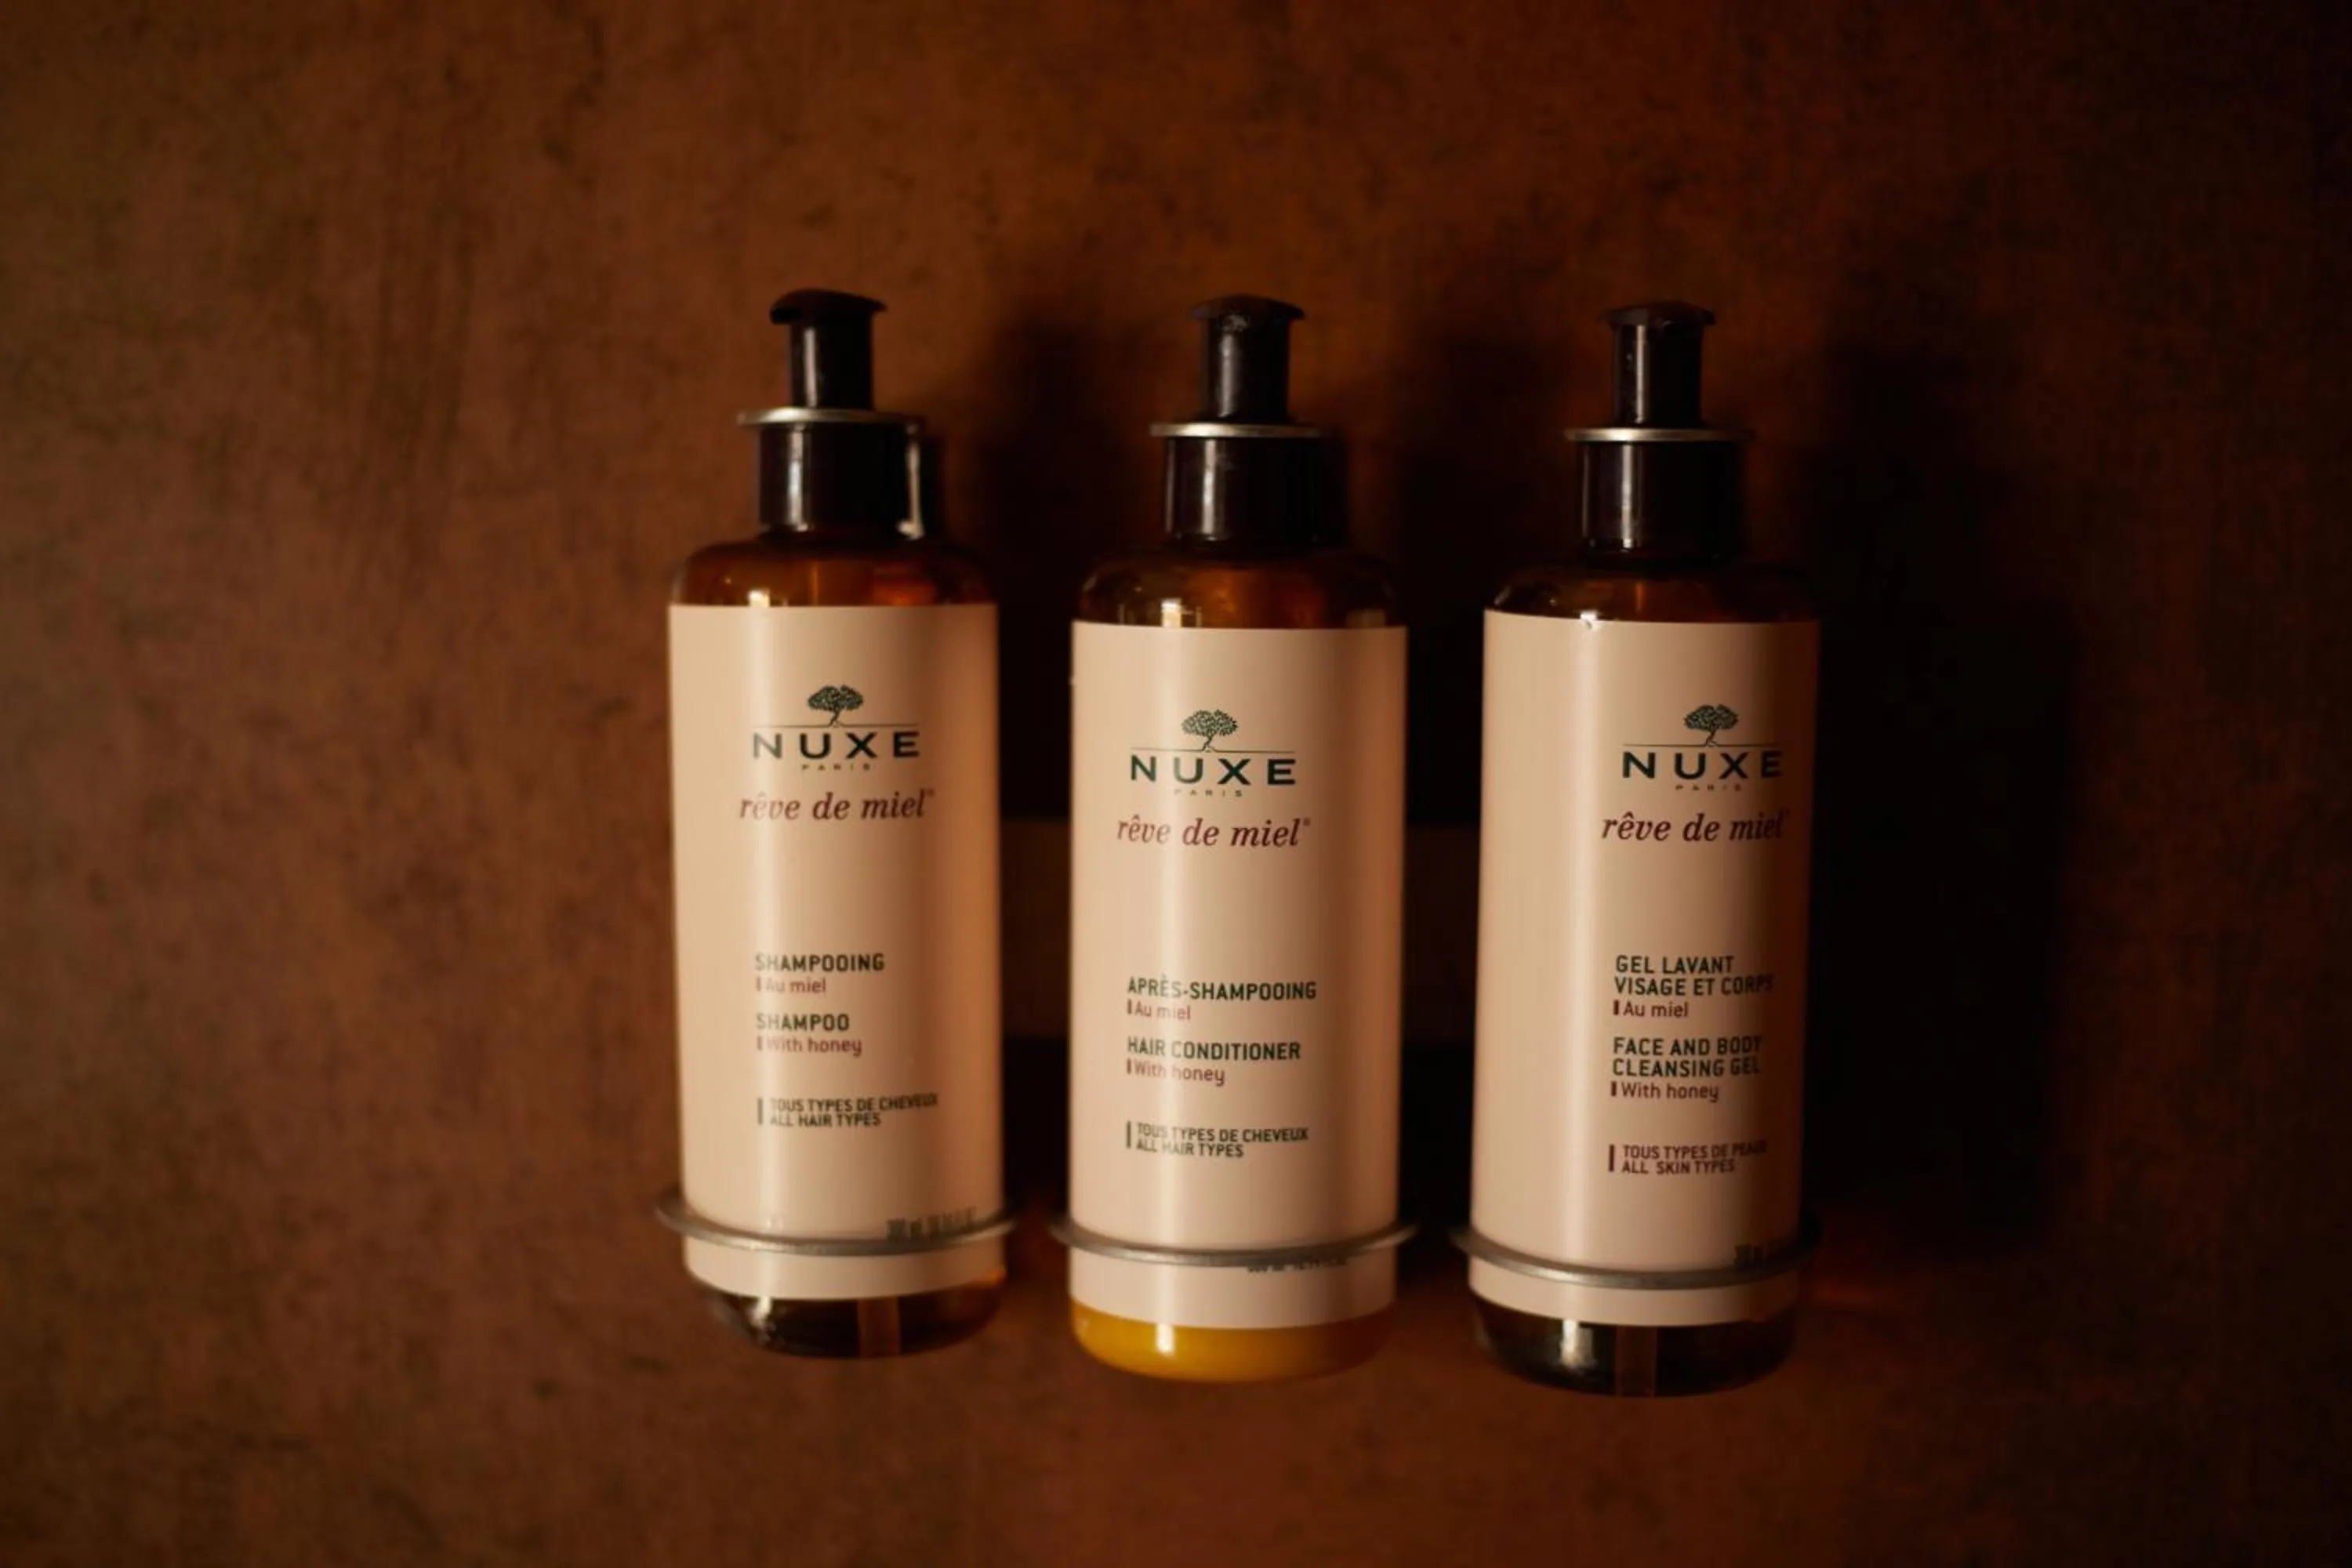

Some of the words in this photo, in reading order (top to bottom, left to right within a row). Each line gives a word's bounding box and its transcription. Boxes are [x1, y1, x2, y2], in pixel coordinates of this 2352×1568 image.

[753, 731, 920, 759] NUXE
[801, 763, 871, 771] PARIS
[1131, 754, 1296, 786] NUXE
[1622, 751, 1782, 779] NUXE
[739, 791, 800, 820] rêve
[812, 791, 851, 820] de
[1116, 814, 1171, 844] rêve
[1182, 817, 1220, 846] de
[1602, 811, 1671, 840] rêve
[1682, 813, 1719, 841] de
[755, 952, 885, 972] SHAMPOOING
[1615, 955, 1654, 974] GEL
[1662, 956, 1734, 975] LAVANT
[766, 978, 784, 993] Au
[789, 978, 826, 993] miel
[1127, 974, 1316, 1001] APRÈS-SHAMPOOING
[1614, 977, 1686, 996] VISAGE
[1693, 978, 1715, 996] ET
[1720, 974, 1774, 996] CORPS
[1134, 1002, 1152, 1018] Au
[1156, 1004, 1191, 1020] miel
[1624, 1001, 1644, 1017] Au
[1651, 1000, 1689, 1018] miel
[756, 1013, 850, 1032] SHAMPOO
[765, 1036, 802, 1052] With
[807, 1036, 862, 1058] honey
[1127, 1036, 1166, 1056] HAIR
[1171, 1040, 1301, 1061] CONDITIONER
[1613, 1036, 1664, 1055] FACE
[1669, 1038, 1710, 1056] AND
[1717, 1034, 1762, 1055] BODY
[1134, 1061, 1167, 1078] With
[1172, 1064, 1225, 1087] honey
[1613, 1058, 1725, 1077] CLEANSING
[1730, 1057, 1759, 1076] GEL
[1621, 1081, 1661, 1098] With
[1666, 1083, 1719, 1102] honey
[769, 1098, 804, 1112] TOUS
[808, 1098, 853, 1112] TYPES
[856, 1097, 875, 1112] DE
[769, 1113, 793, 1127] ALL
[797, 1113, 832, 1127] HAIR
[837, 1112, 882, 1127] TYPES
[1137, 1123, 1167, 1138] TOUS
[1171, 1126, 1214, 1142] TYPES
[1219, 1128, 1239, 1142] DE
[1242, 1127, 1308, 1142] CHEVEUX
[1136, 1138, 1157, 1152] ALL
[1162, 1140, 1194, 1155] HAIR
[1199, 1142, 1243, 1158] TYPES
[1623, 1145, 1660, 1160] TOUS
[1664, 1145, 1707, 1160] TYPES
[1711, 1143, 1726, 1159] DE
[1621, 1160, 1648, 1174] ALL
[1656, 1160, 1690, 1174] SKIN
[1693, 1159, 1735, 1174] TYPES
